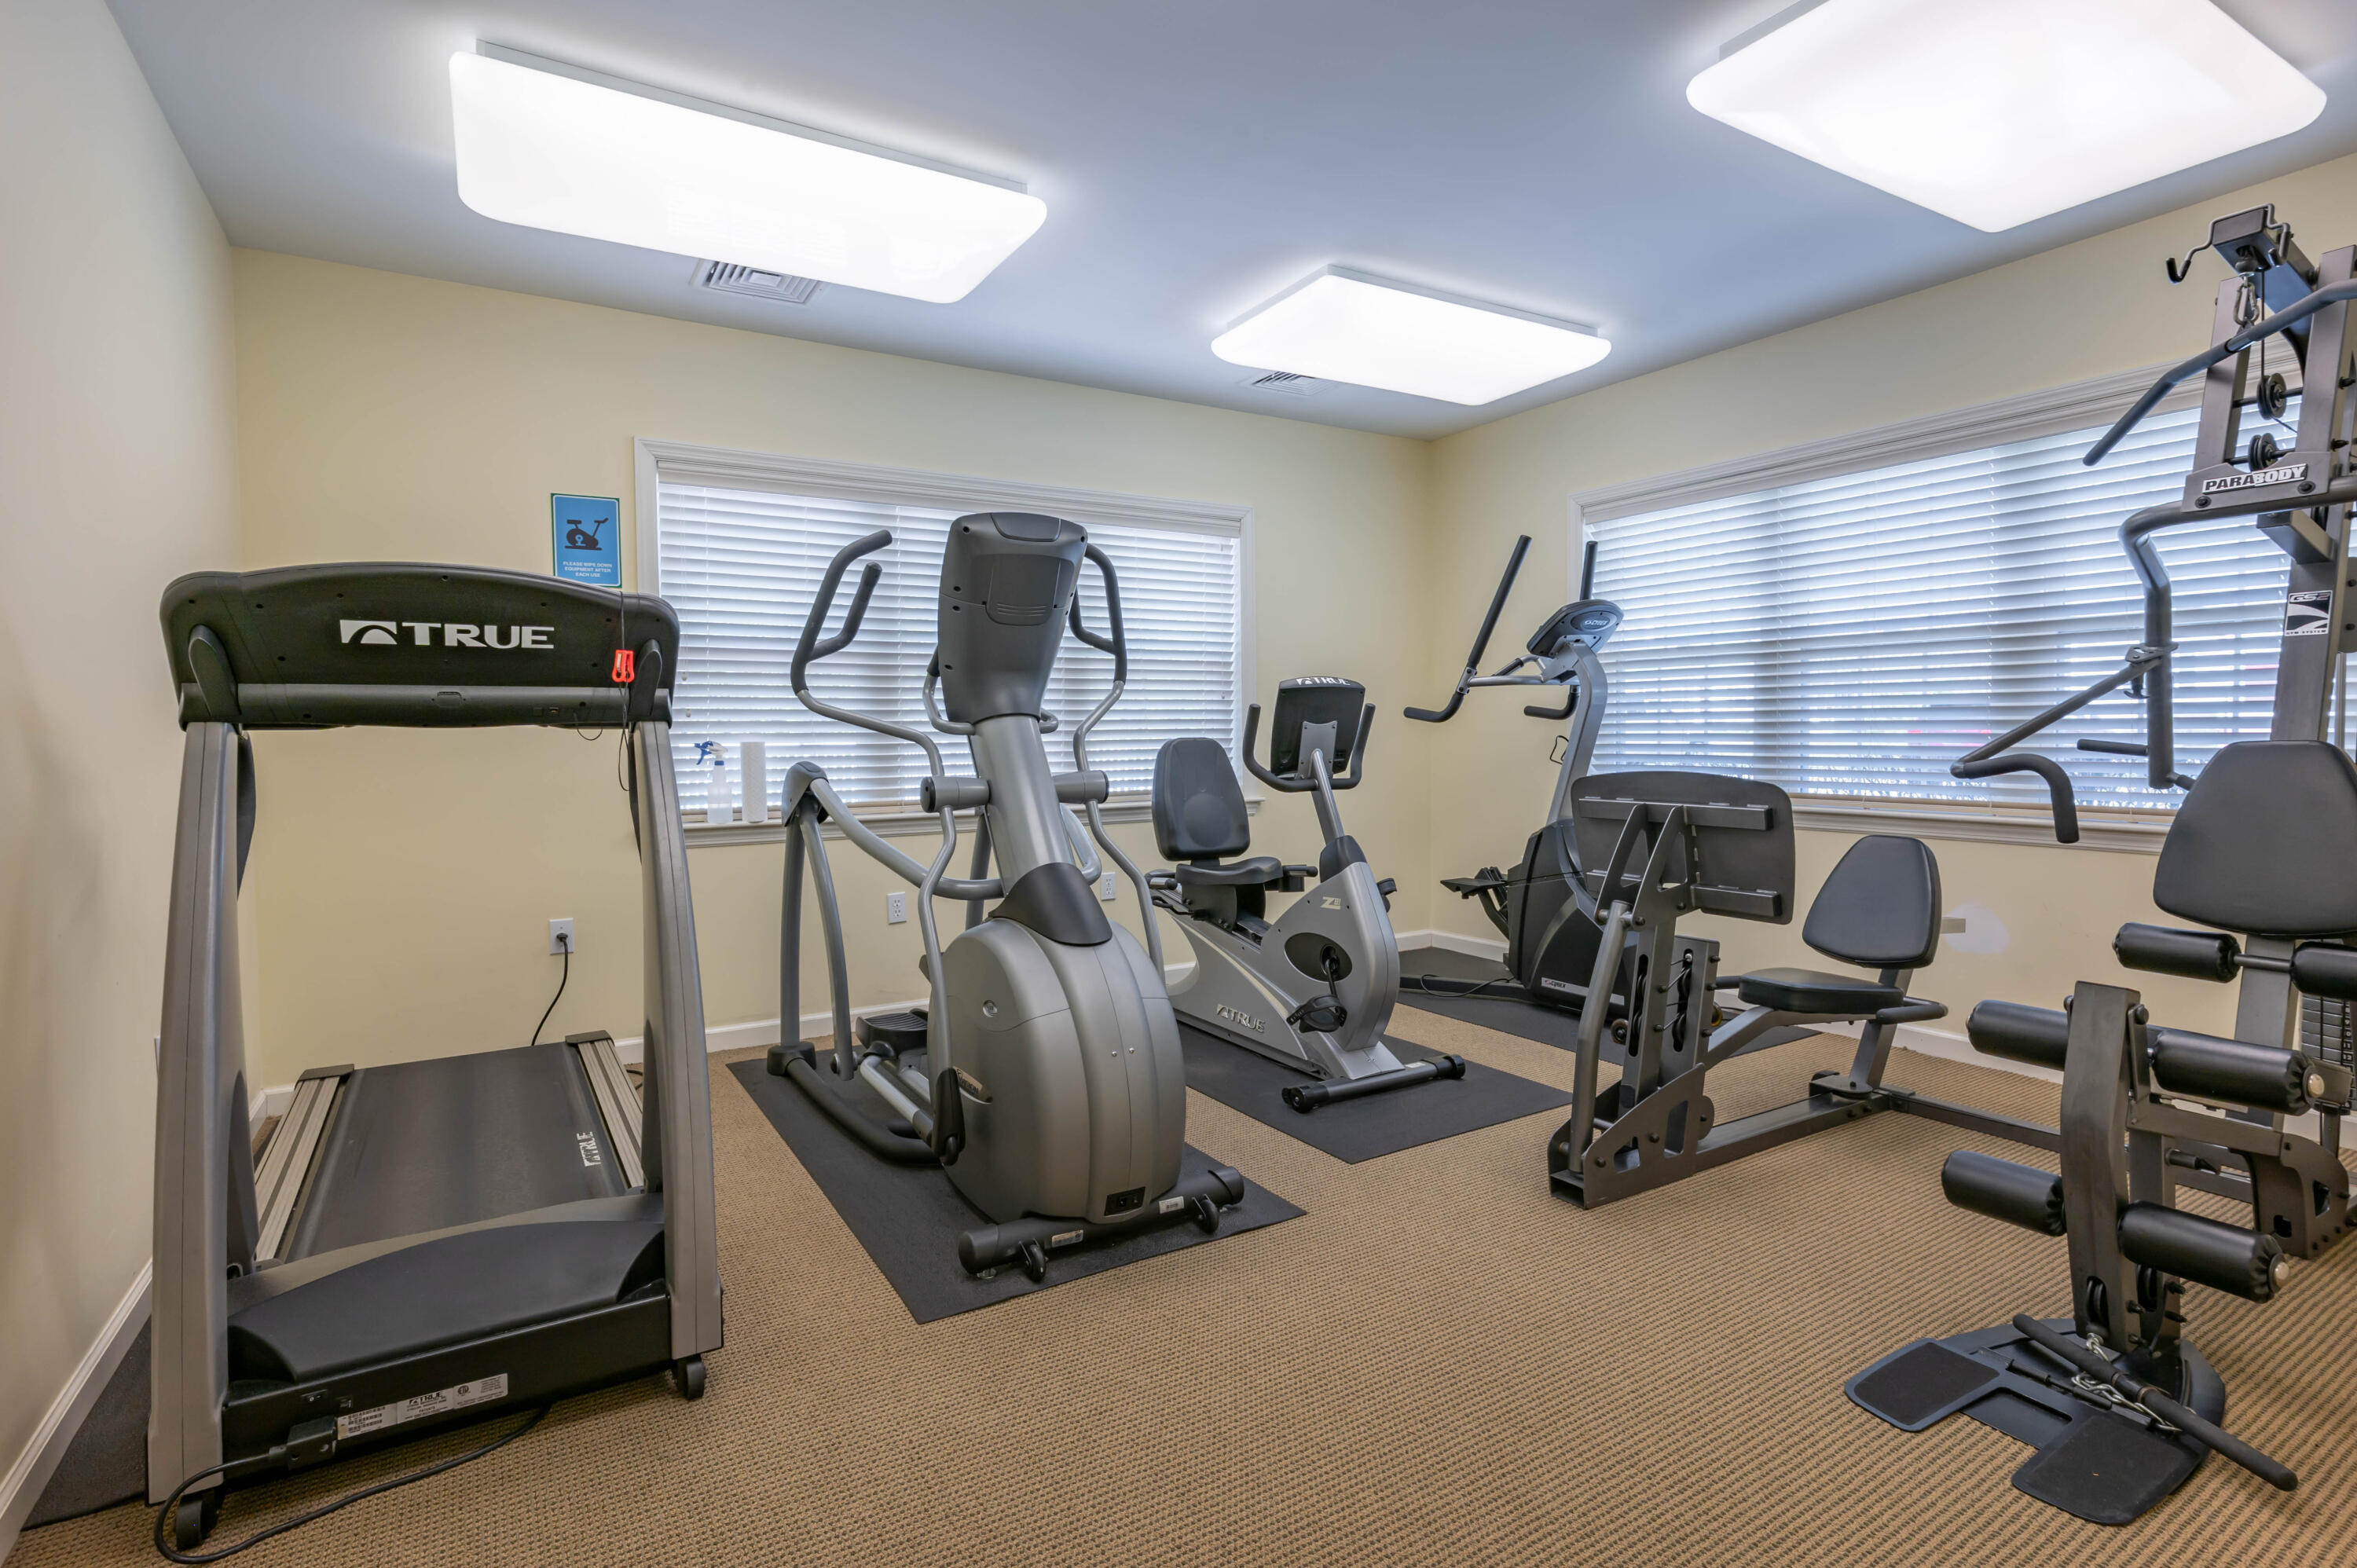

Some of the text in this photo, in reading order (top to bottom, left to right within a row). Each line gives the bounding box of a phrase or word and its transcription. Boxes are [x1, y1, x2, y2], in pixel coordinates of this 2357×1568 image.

[2205, 466, 2307, 491] PARABODY
[2290, 593, 2330, 603] GS2
[401, 621, 555, 650] TRUE
[1313, 676, 1351, 686] TRUE
[1229, 1008, 1266, 1033] TRUE
